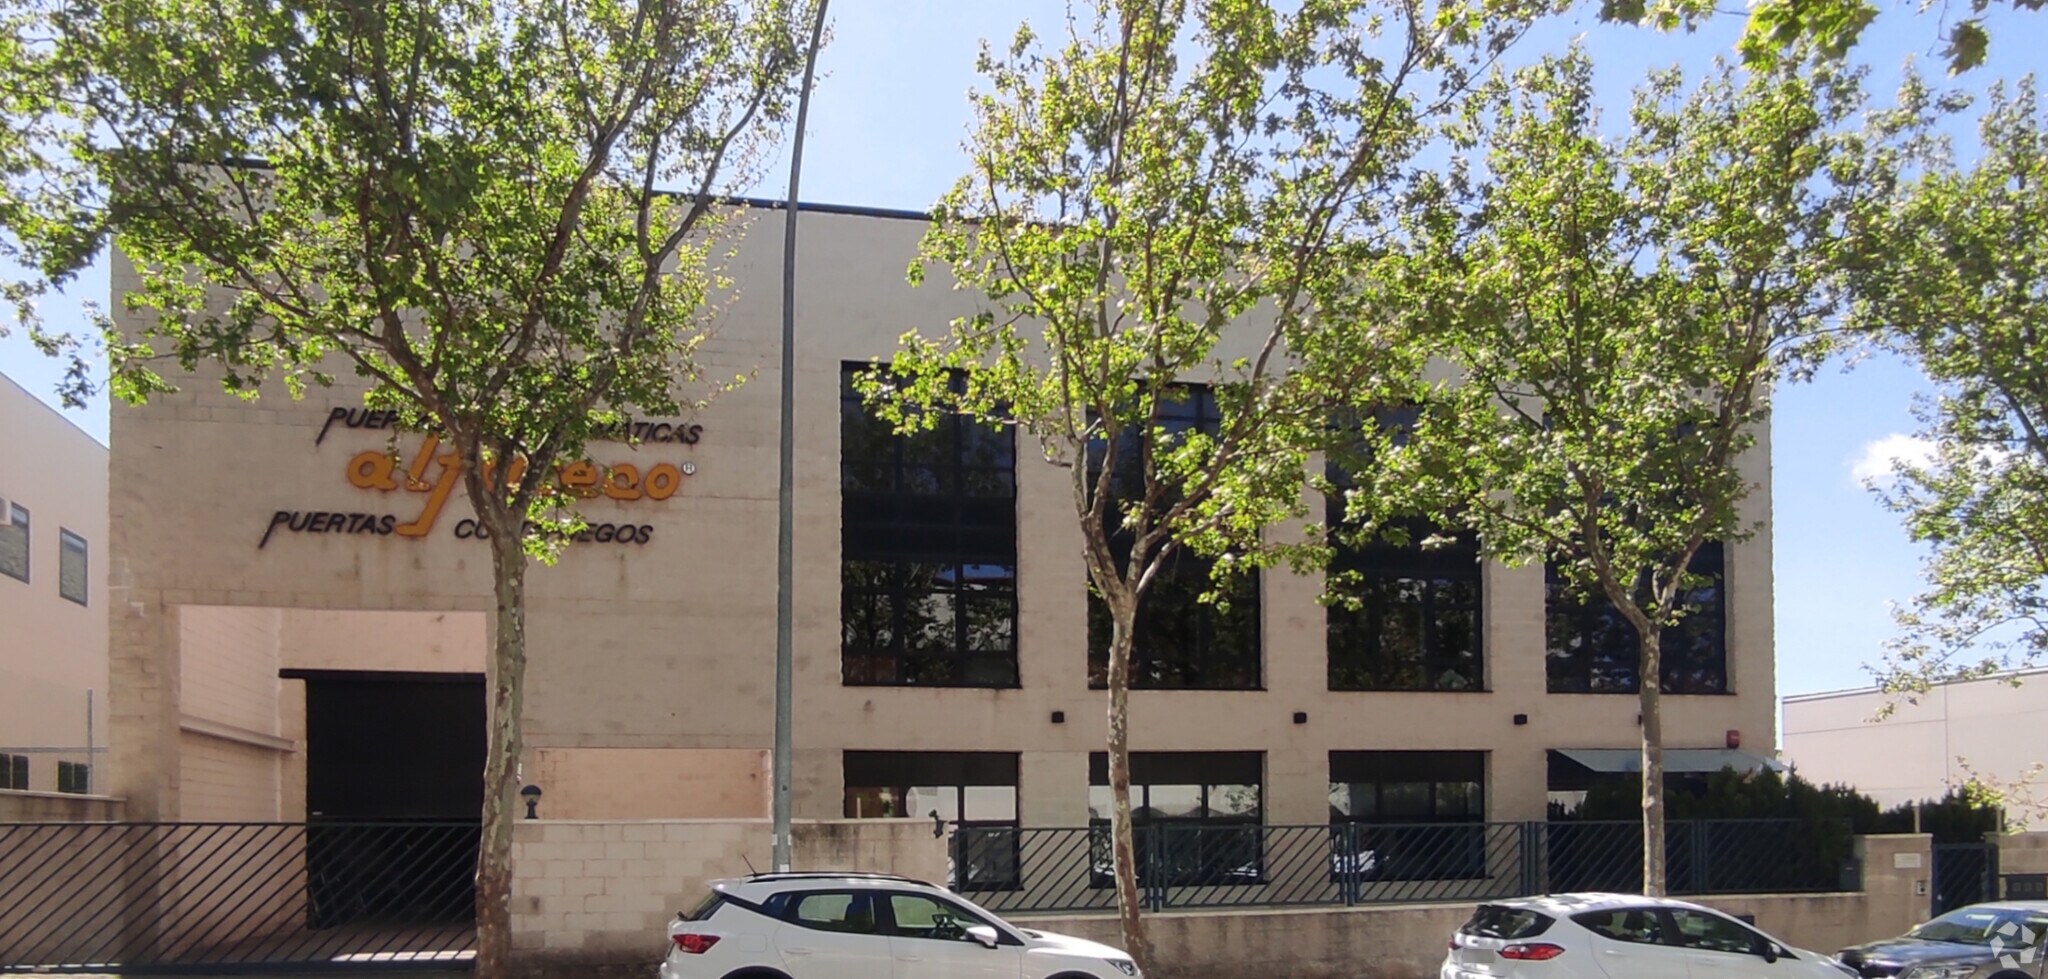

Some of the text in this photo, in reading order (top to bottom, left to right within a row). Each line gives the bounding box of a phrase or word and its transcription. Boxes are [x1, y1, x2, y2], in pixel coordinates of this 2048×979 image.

[315, 406, 703, 447] PUER ATICAS
[346, 430, 681, 537] alfeco
[258, 511, 653, 549] PUERTAS COEGOS
